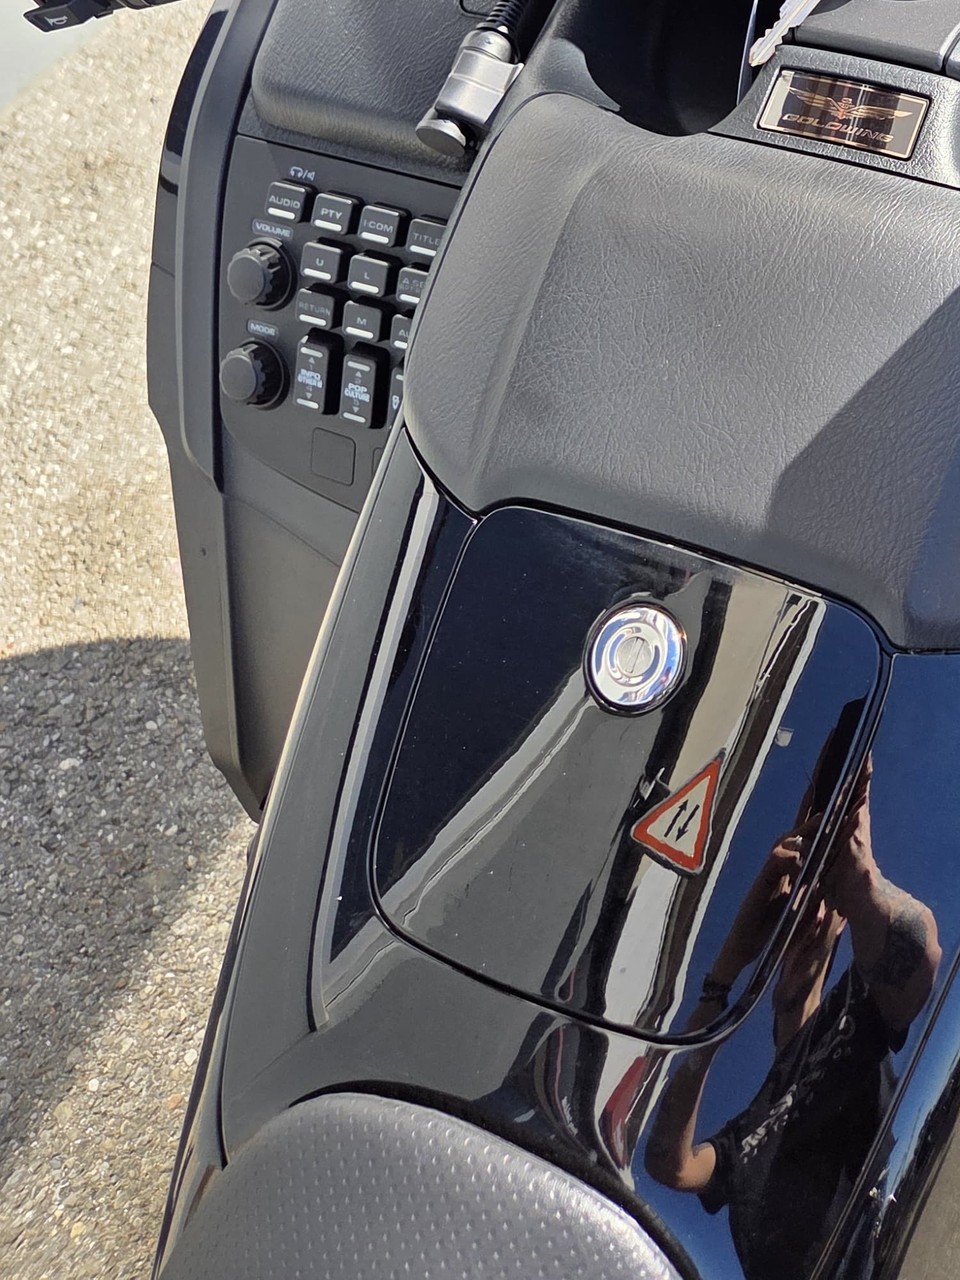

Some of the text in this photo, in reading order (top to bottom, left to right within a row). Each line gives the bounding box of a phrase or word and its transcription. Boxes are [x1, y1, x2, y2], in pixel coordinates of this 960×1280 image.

[781, 113, 894, 143] GOLDWING
[269, 194, 301, 209] AUDIO
[320, 207, 343, 220] PTY
[255, 221, 291, 238] VOLUME
[413, 232, 440, 246] TITLE
[315, 257, 325, 267] U
[363, 271, 371, 280] L
[299, 303, 331, 316] RETURN
[356, 316, 367, 326] M
[250, 322, 276, 336] MODE
[300, 368, 321, 380] INFO
[348, 382, 368, 393] POP
[344, 387, 371, 403] CULTURE
